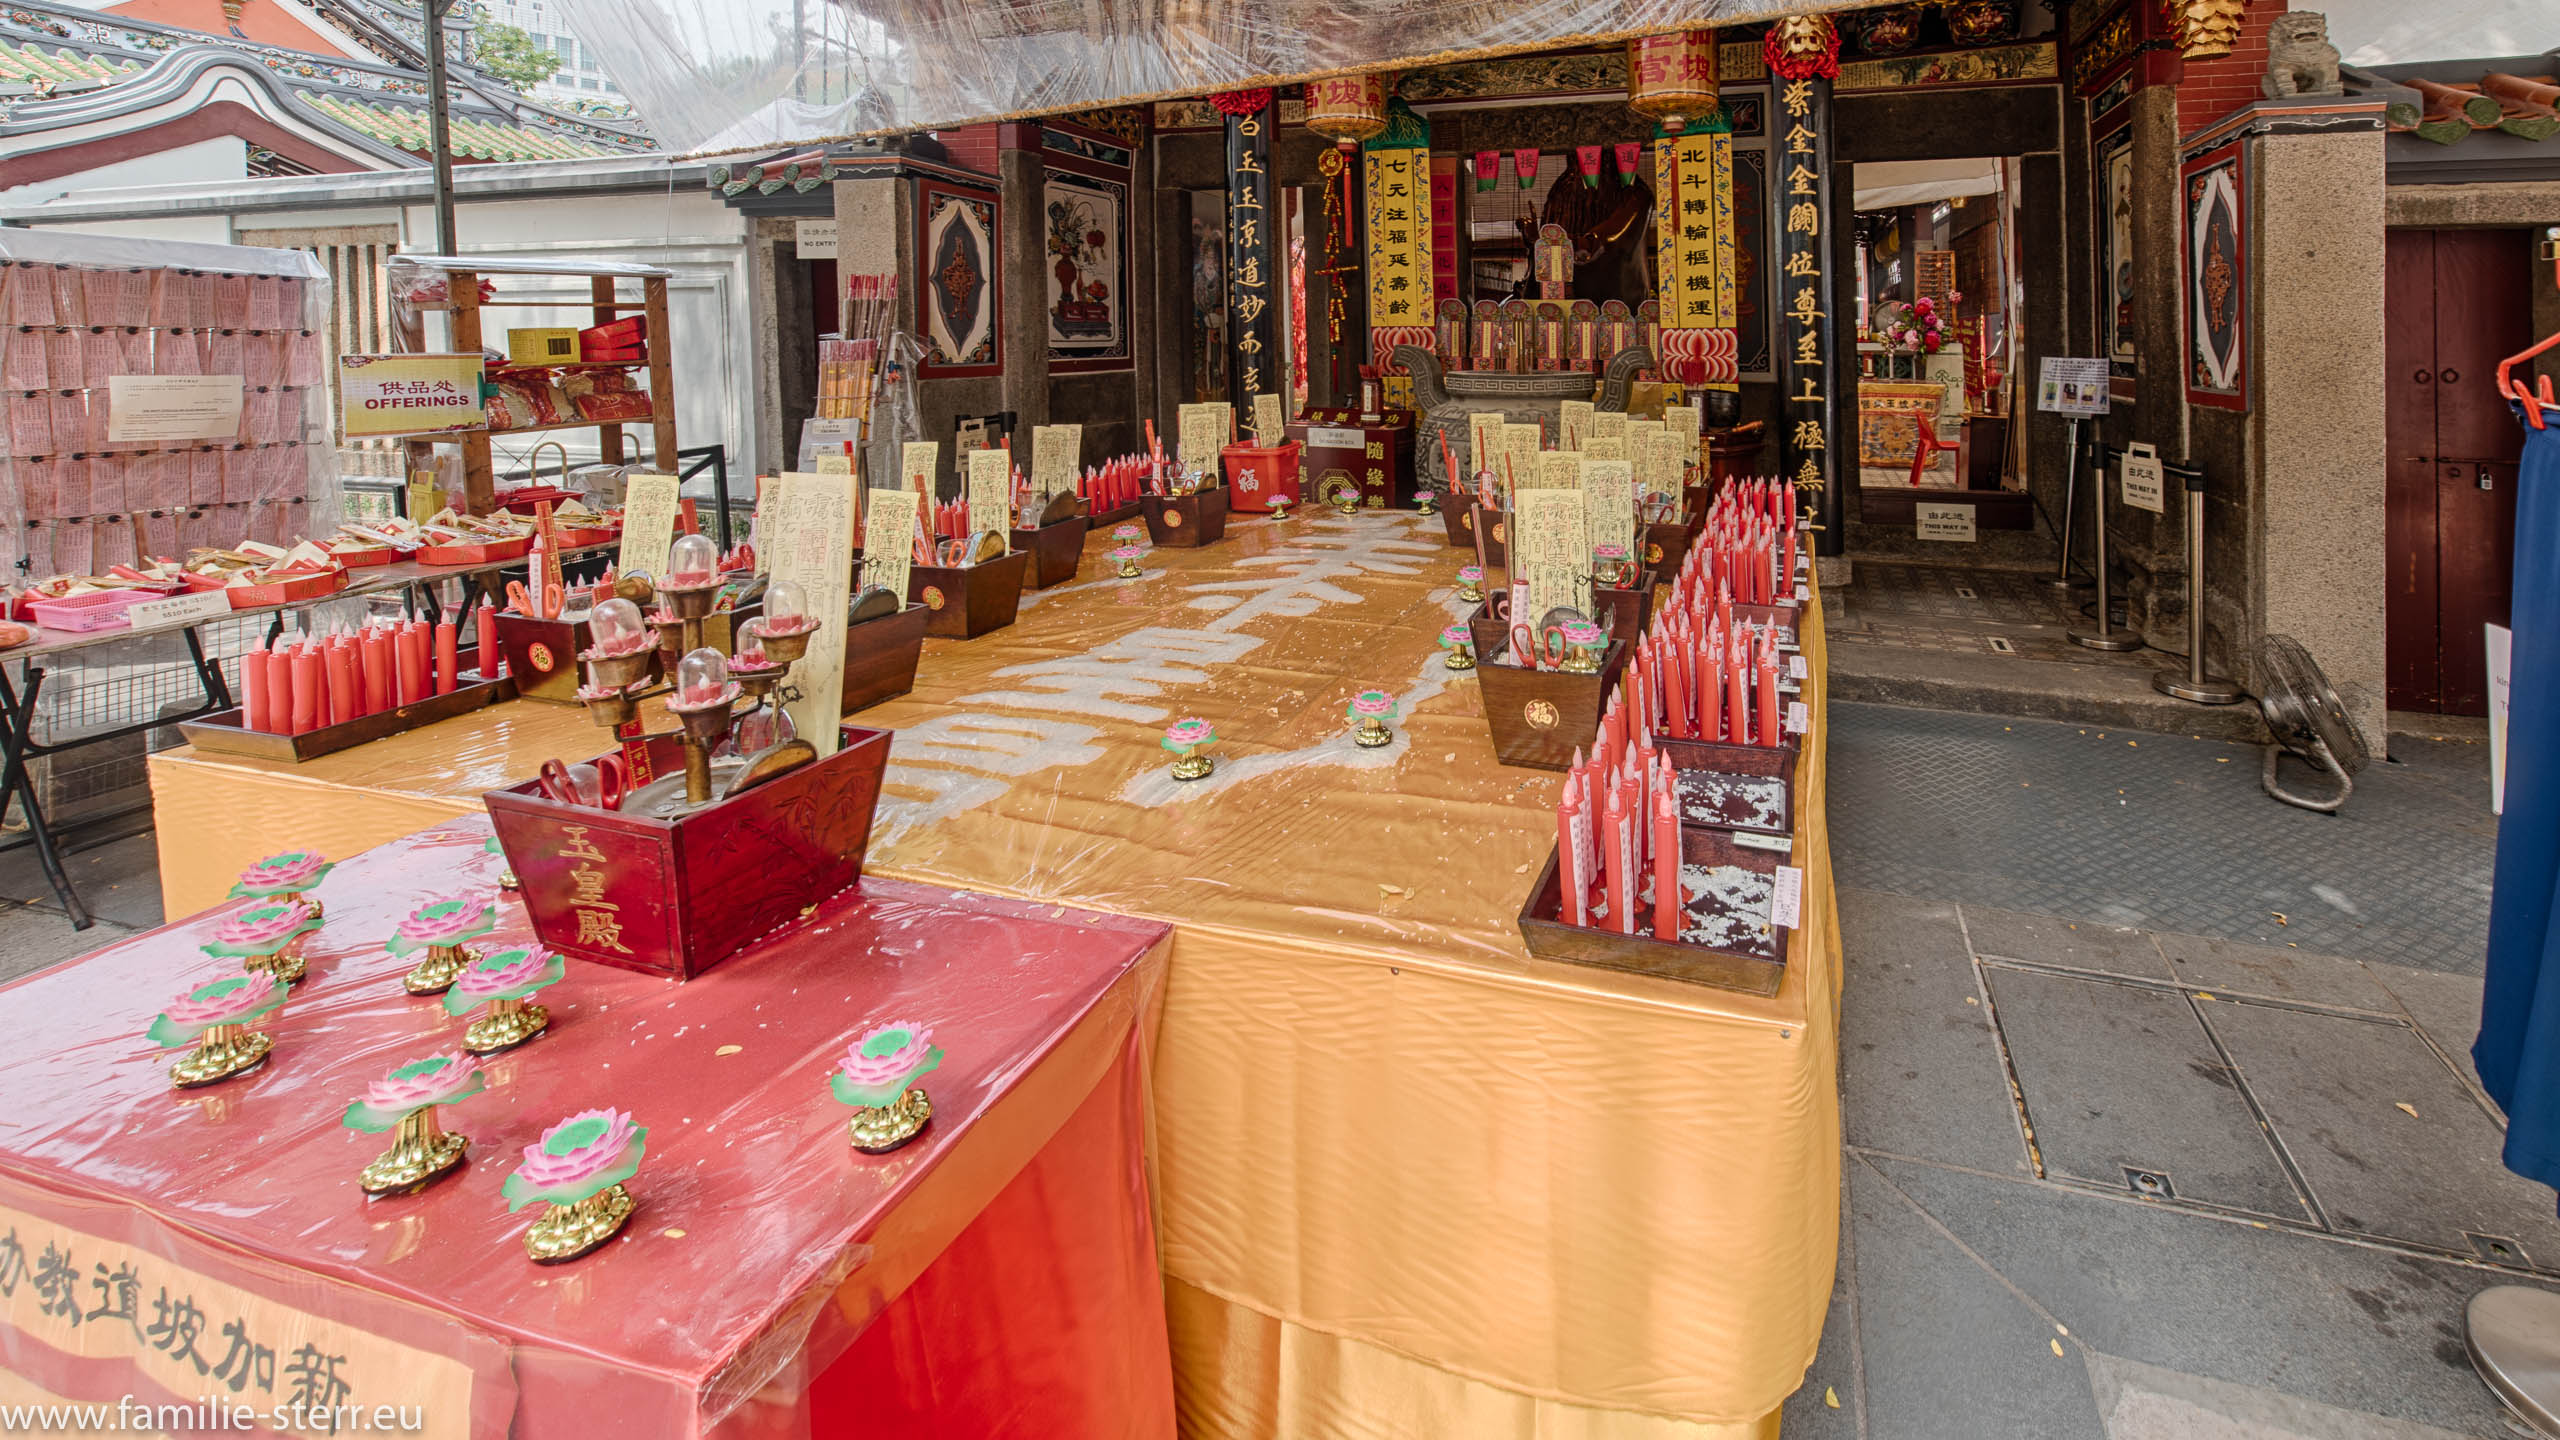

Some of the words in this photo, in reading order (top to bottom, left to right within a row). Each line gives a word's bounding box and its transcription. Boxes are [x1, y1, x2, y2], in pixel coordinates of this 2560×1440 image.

[378, 379, 456, 395] 供品处
[364, 395, 469, 410] OFFERINGS
[1238, 468, 1259, 493] 福
[559, 826, 634, 954] 玉皇殿
